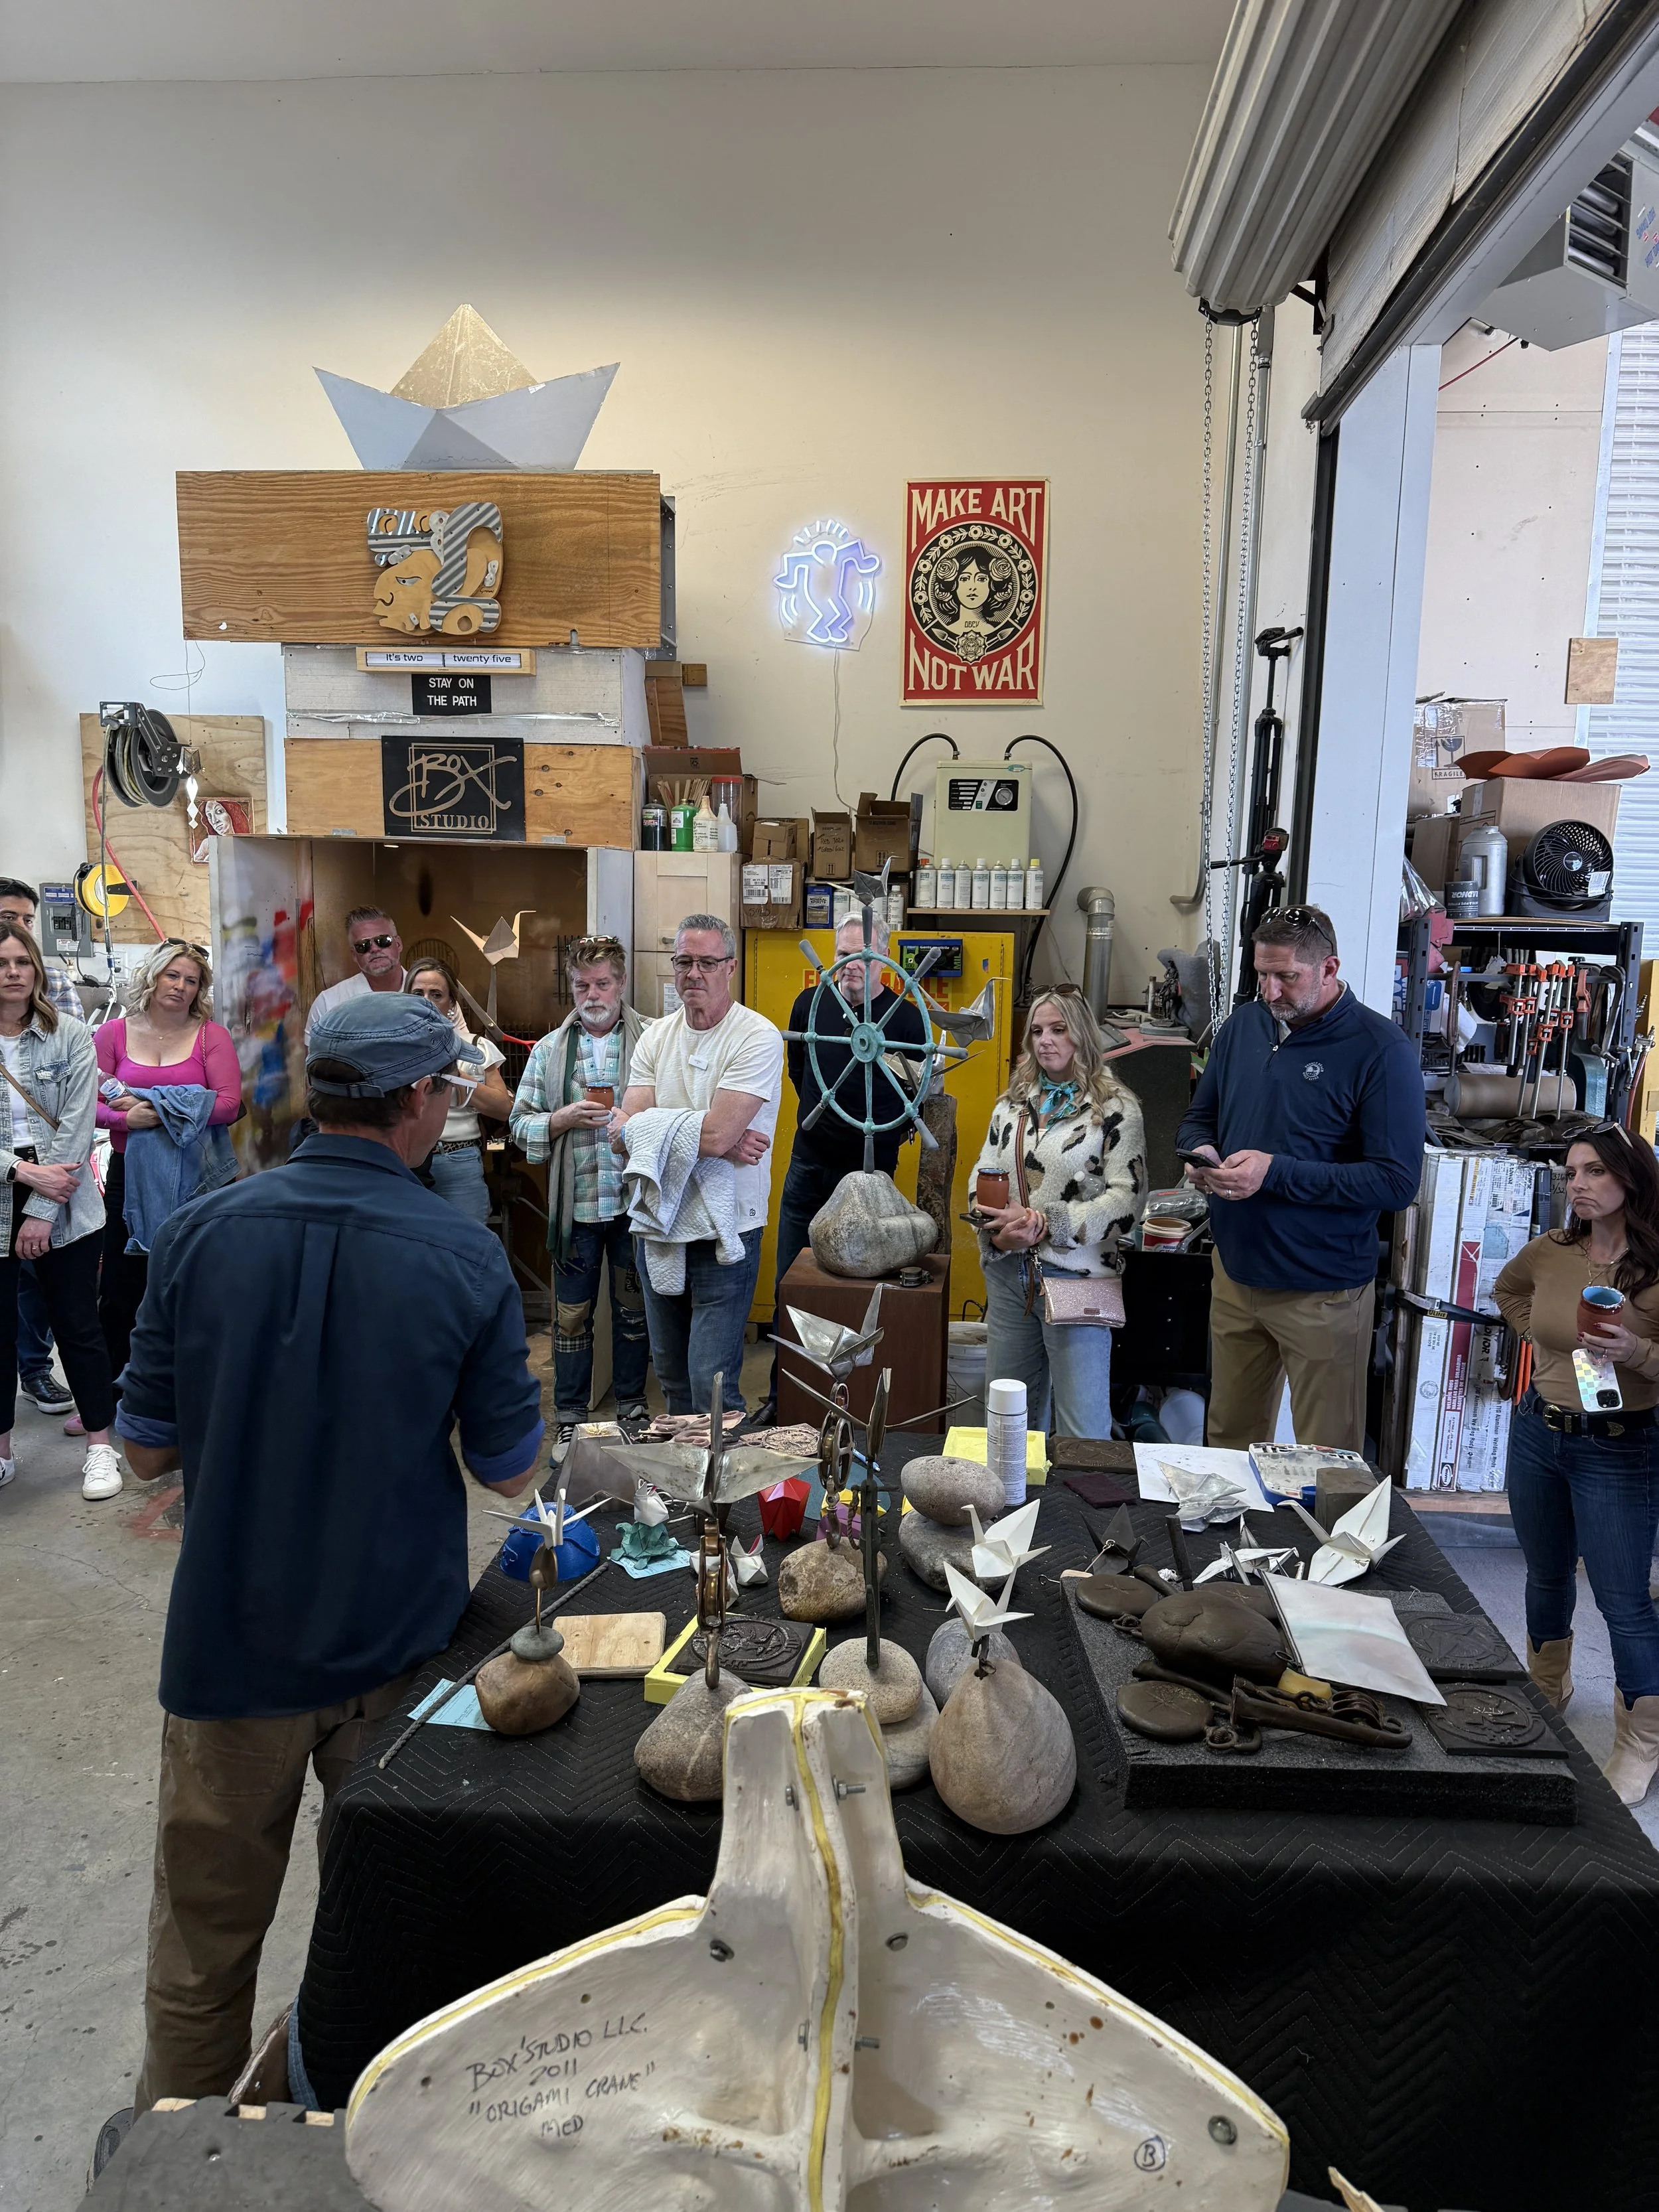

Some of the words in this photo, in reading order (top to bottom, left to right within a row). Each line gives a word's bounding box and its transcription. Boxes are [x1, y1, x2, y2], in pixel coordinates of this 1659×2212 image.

[911, 488, 982, 553] MAKE
[989, 488, 1042, 547] ART
[403, 653, 423, 662] two
[453, 654, 490, 664] twenty
[492, 654, 512, 663] five
[907, 628, 967, 690] NOT
[972, 627, 1036, 690] WAR
[429, 678, 453, 689] STAY
[458, 678, 474, 689] ON
[427, 695, 448, 706] THE
[453, 696, 477, 707] PATH
[420, 814, 490, 830] STUDIO
[1490, 1437, 1499, 1456] Welding
[529, 2058, 577, 2086] 2011
[541, 2114, 584, 2138] MED
[1142, 2144, 1156, 2168] B
